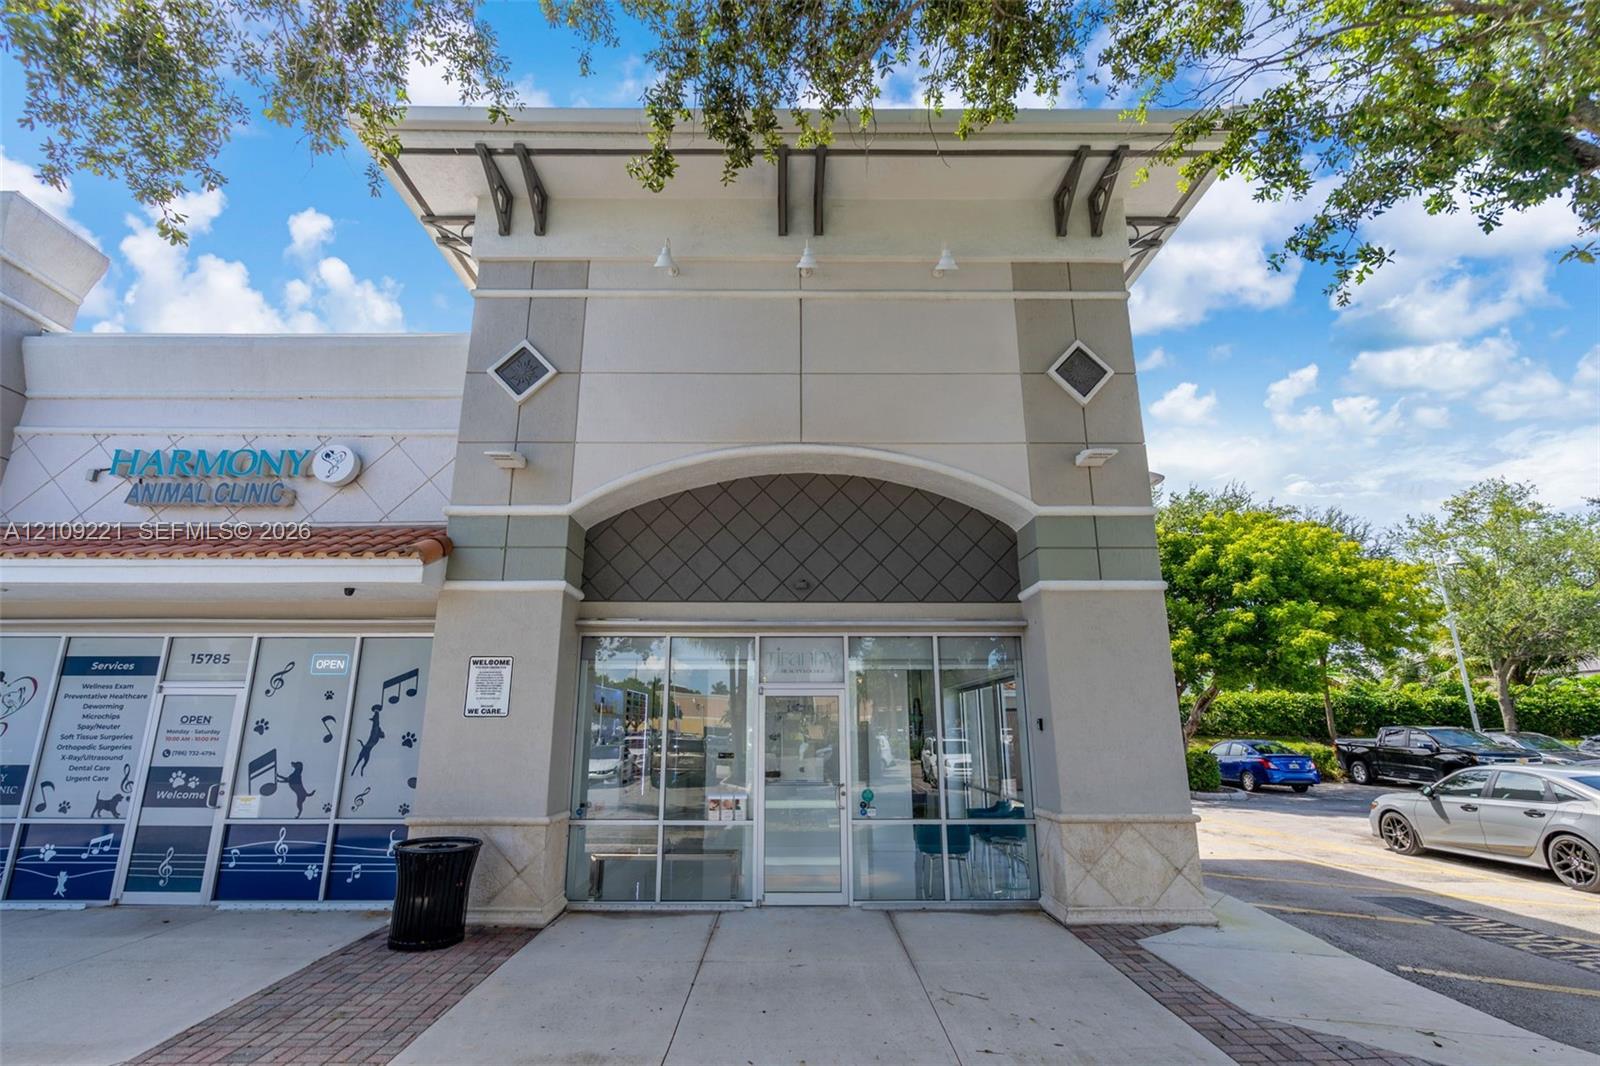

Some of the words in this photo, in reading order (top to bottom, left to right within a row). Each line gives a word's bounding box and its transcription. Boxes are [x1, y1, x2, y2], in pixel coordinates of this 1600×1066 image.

[109, 448, 311, 477] HARMONY
[124, 482, 207, 504] ANIMAL
[214, 482, 285, 504] CLINIC
[191, 653, 231, 664] 15785
[91, 661, 135, 670] Services
[316, 659, 345, 669] OPEN
[82, 703, 125, 711] Deworming
[180, 715, 212, 724] OPEN
[77, 723, 121, 731] Spay/Neuter
[100, 733, 133, 741] Surgeries
[98, 744, 132, 752] Surgeries
[61, 754, 124, 762] X-Ray/Ultrasound
[65, 775, 91, 783] Urgent
[155, 789, 206, 800] Welcome
